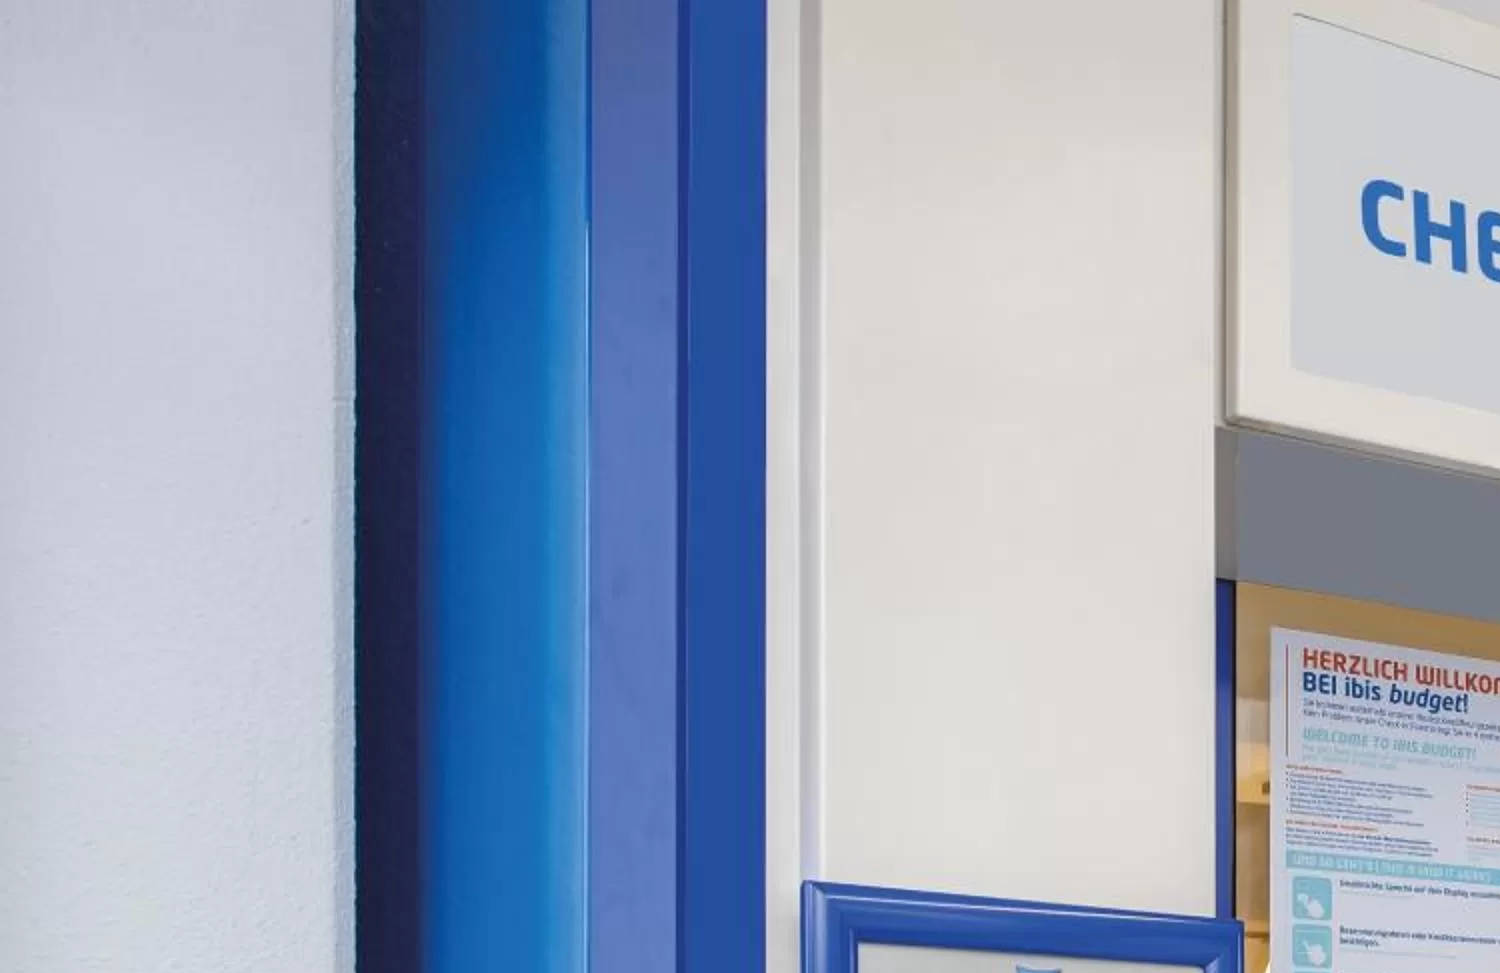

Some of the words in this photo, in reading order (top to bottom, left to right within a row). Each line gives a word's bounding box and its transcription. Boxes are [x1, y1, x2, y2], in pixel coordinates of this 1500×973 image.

[1303, 647, 1408, 682] HERZLICH
[1303, 672, 1337, 695] BEI
[1345, 677, 1381, 701] ibis
[1389, 685, 1469, 714] budget!
[1303, 727, 1369, 746] WELCOME
[1371, 735, 1389, 749] TO
